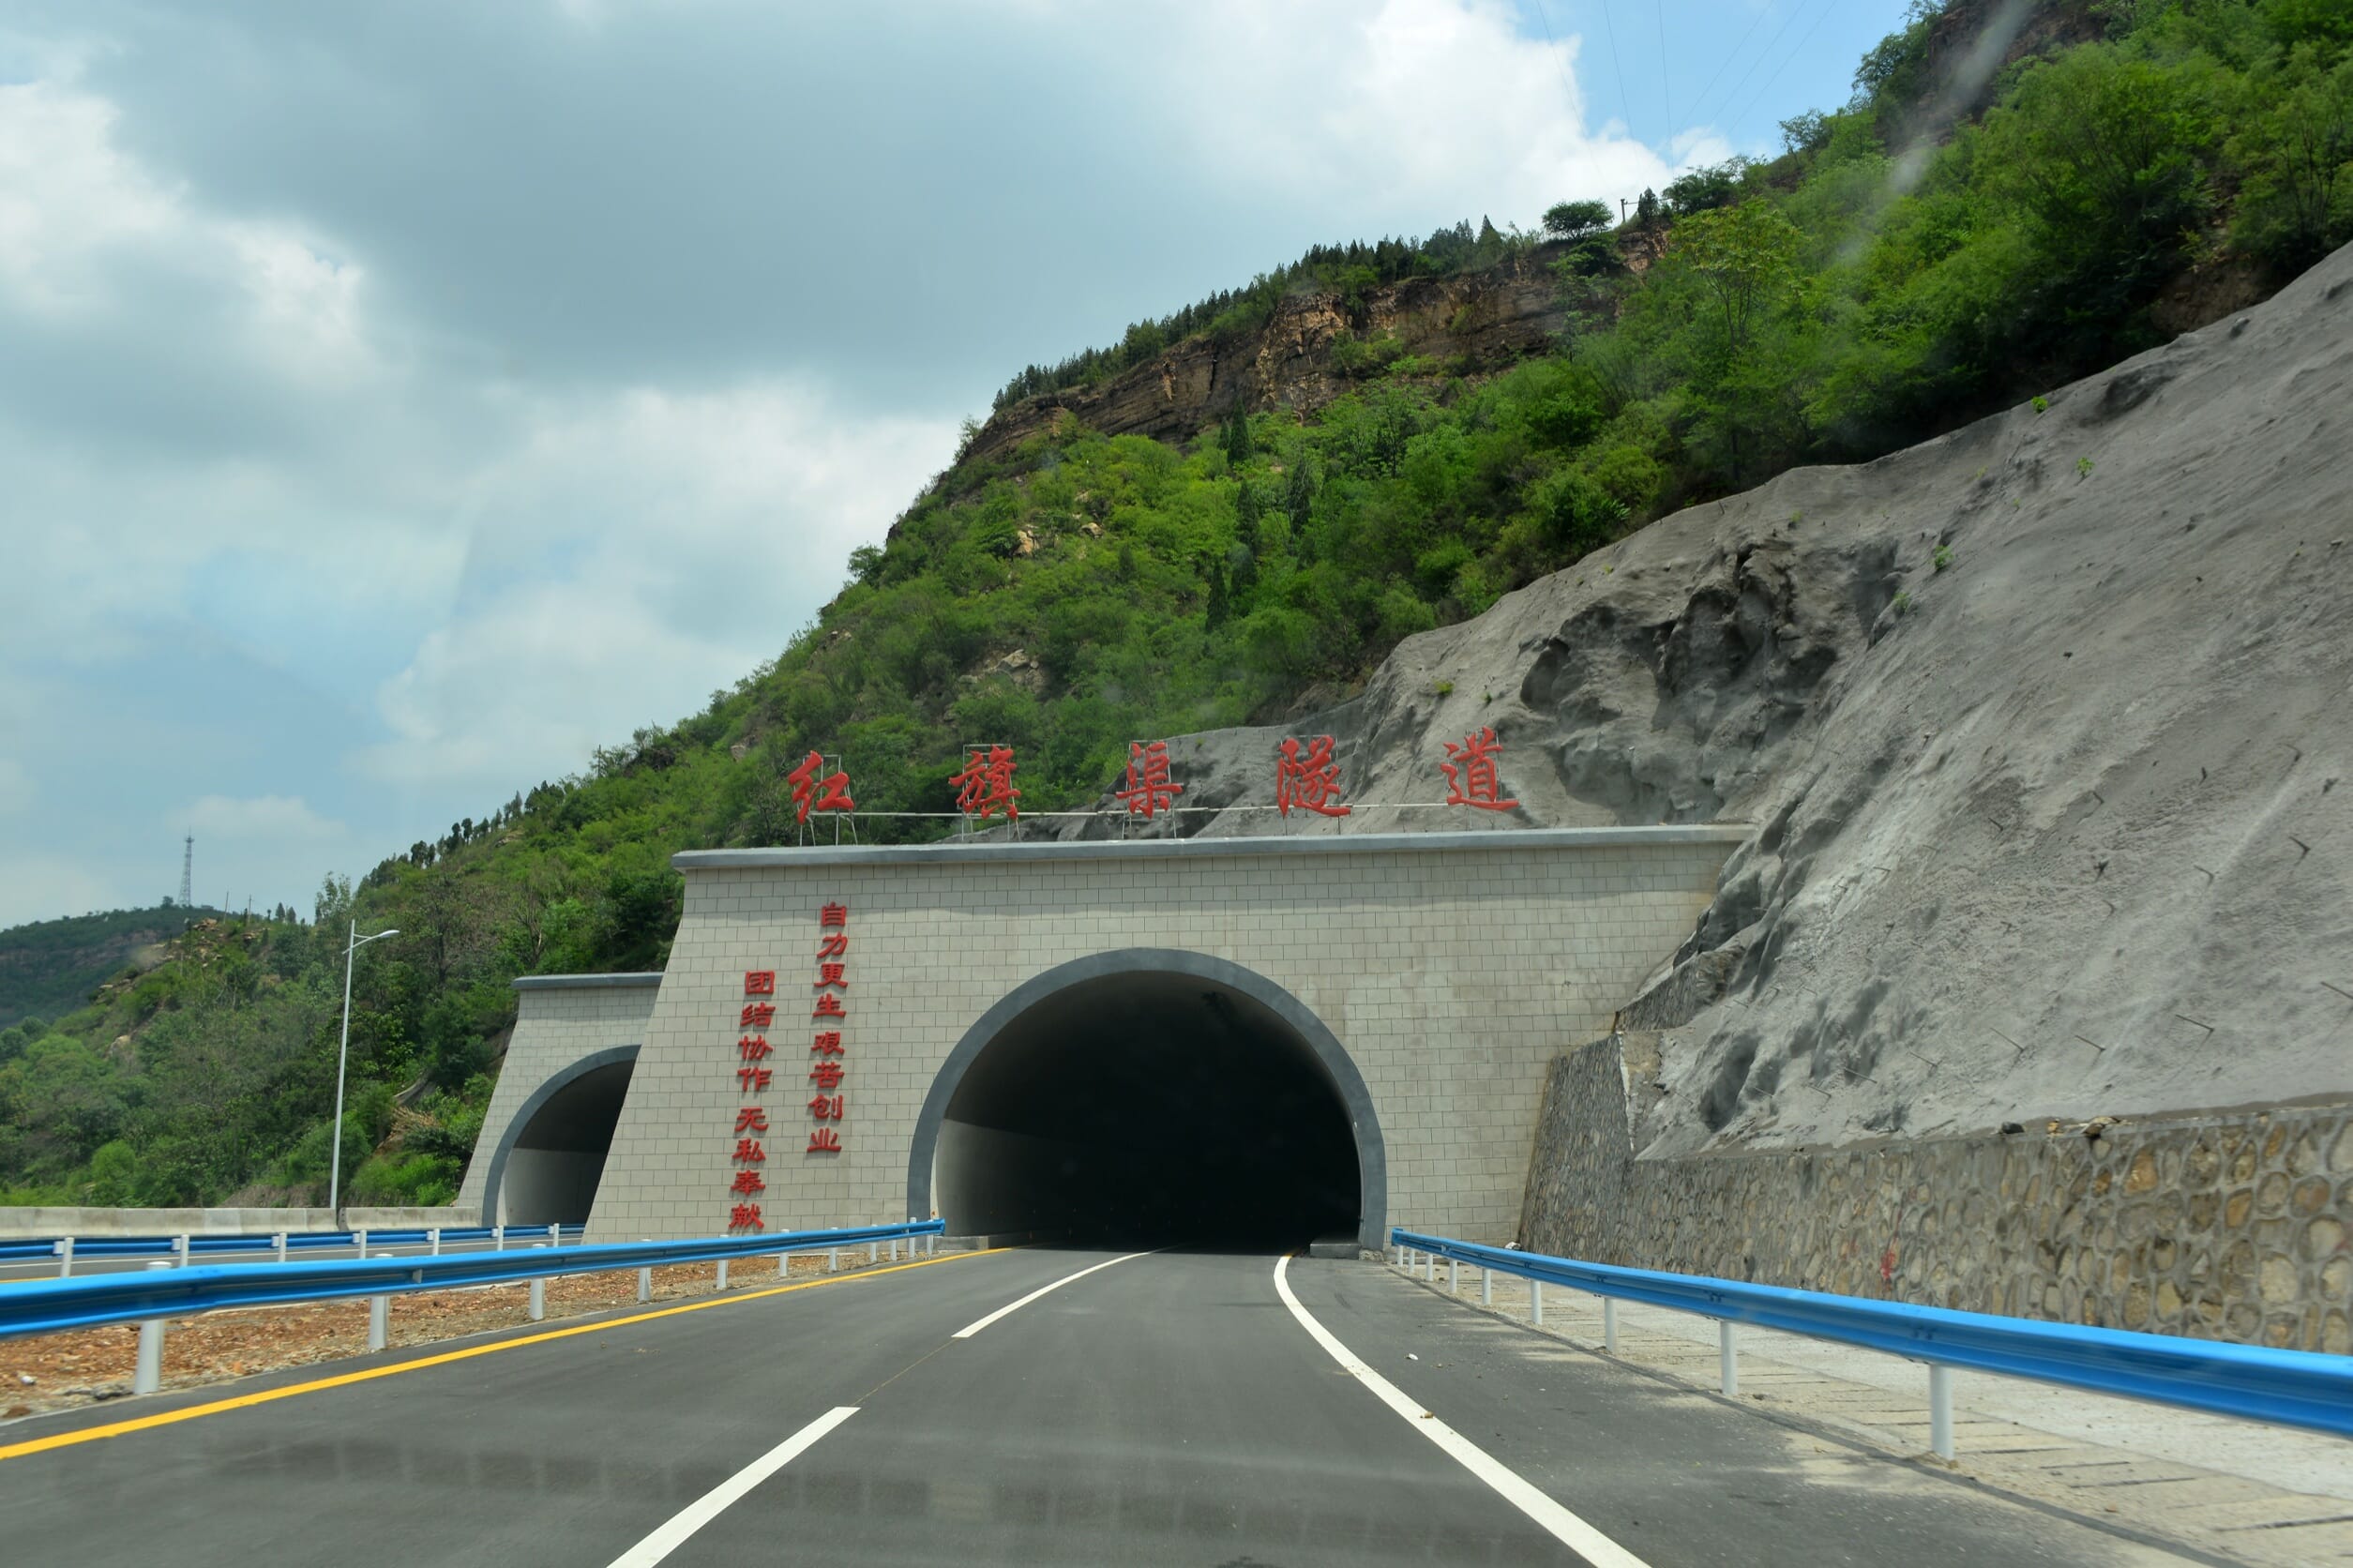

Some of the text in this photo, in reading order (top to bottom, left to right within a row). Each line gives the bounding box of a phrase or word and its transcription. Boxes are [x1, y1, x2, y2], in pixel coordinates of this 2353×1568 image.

[788, 727, 1519, 824] 红旗渠隧道
[728, 970, 777, 1229] 团结协作无私奉献
[807, 901, 849, 1153] 自力更生艰苦创业
